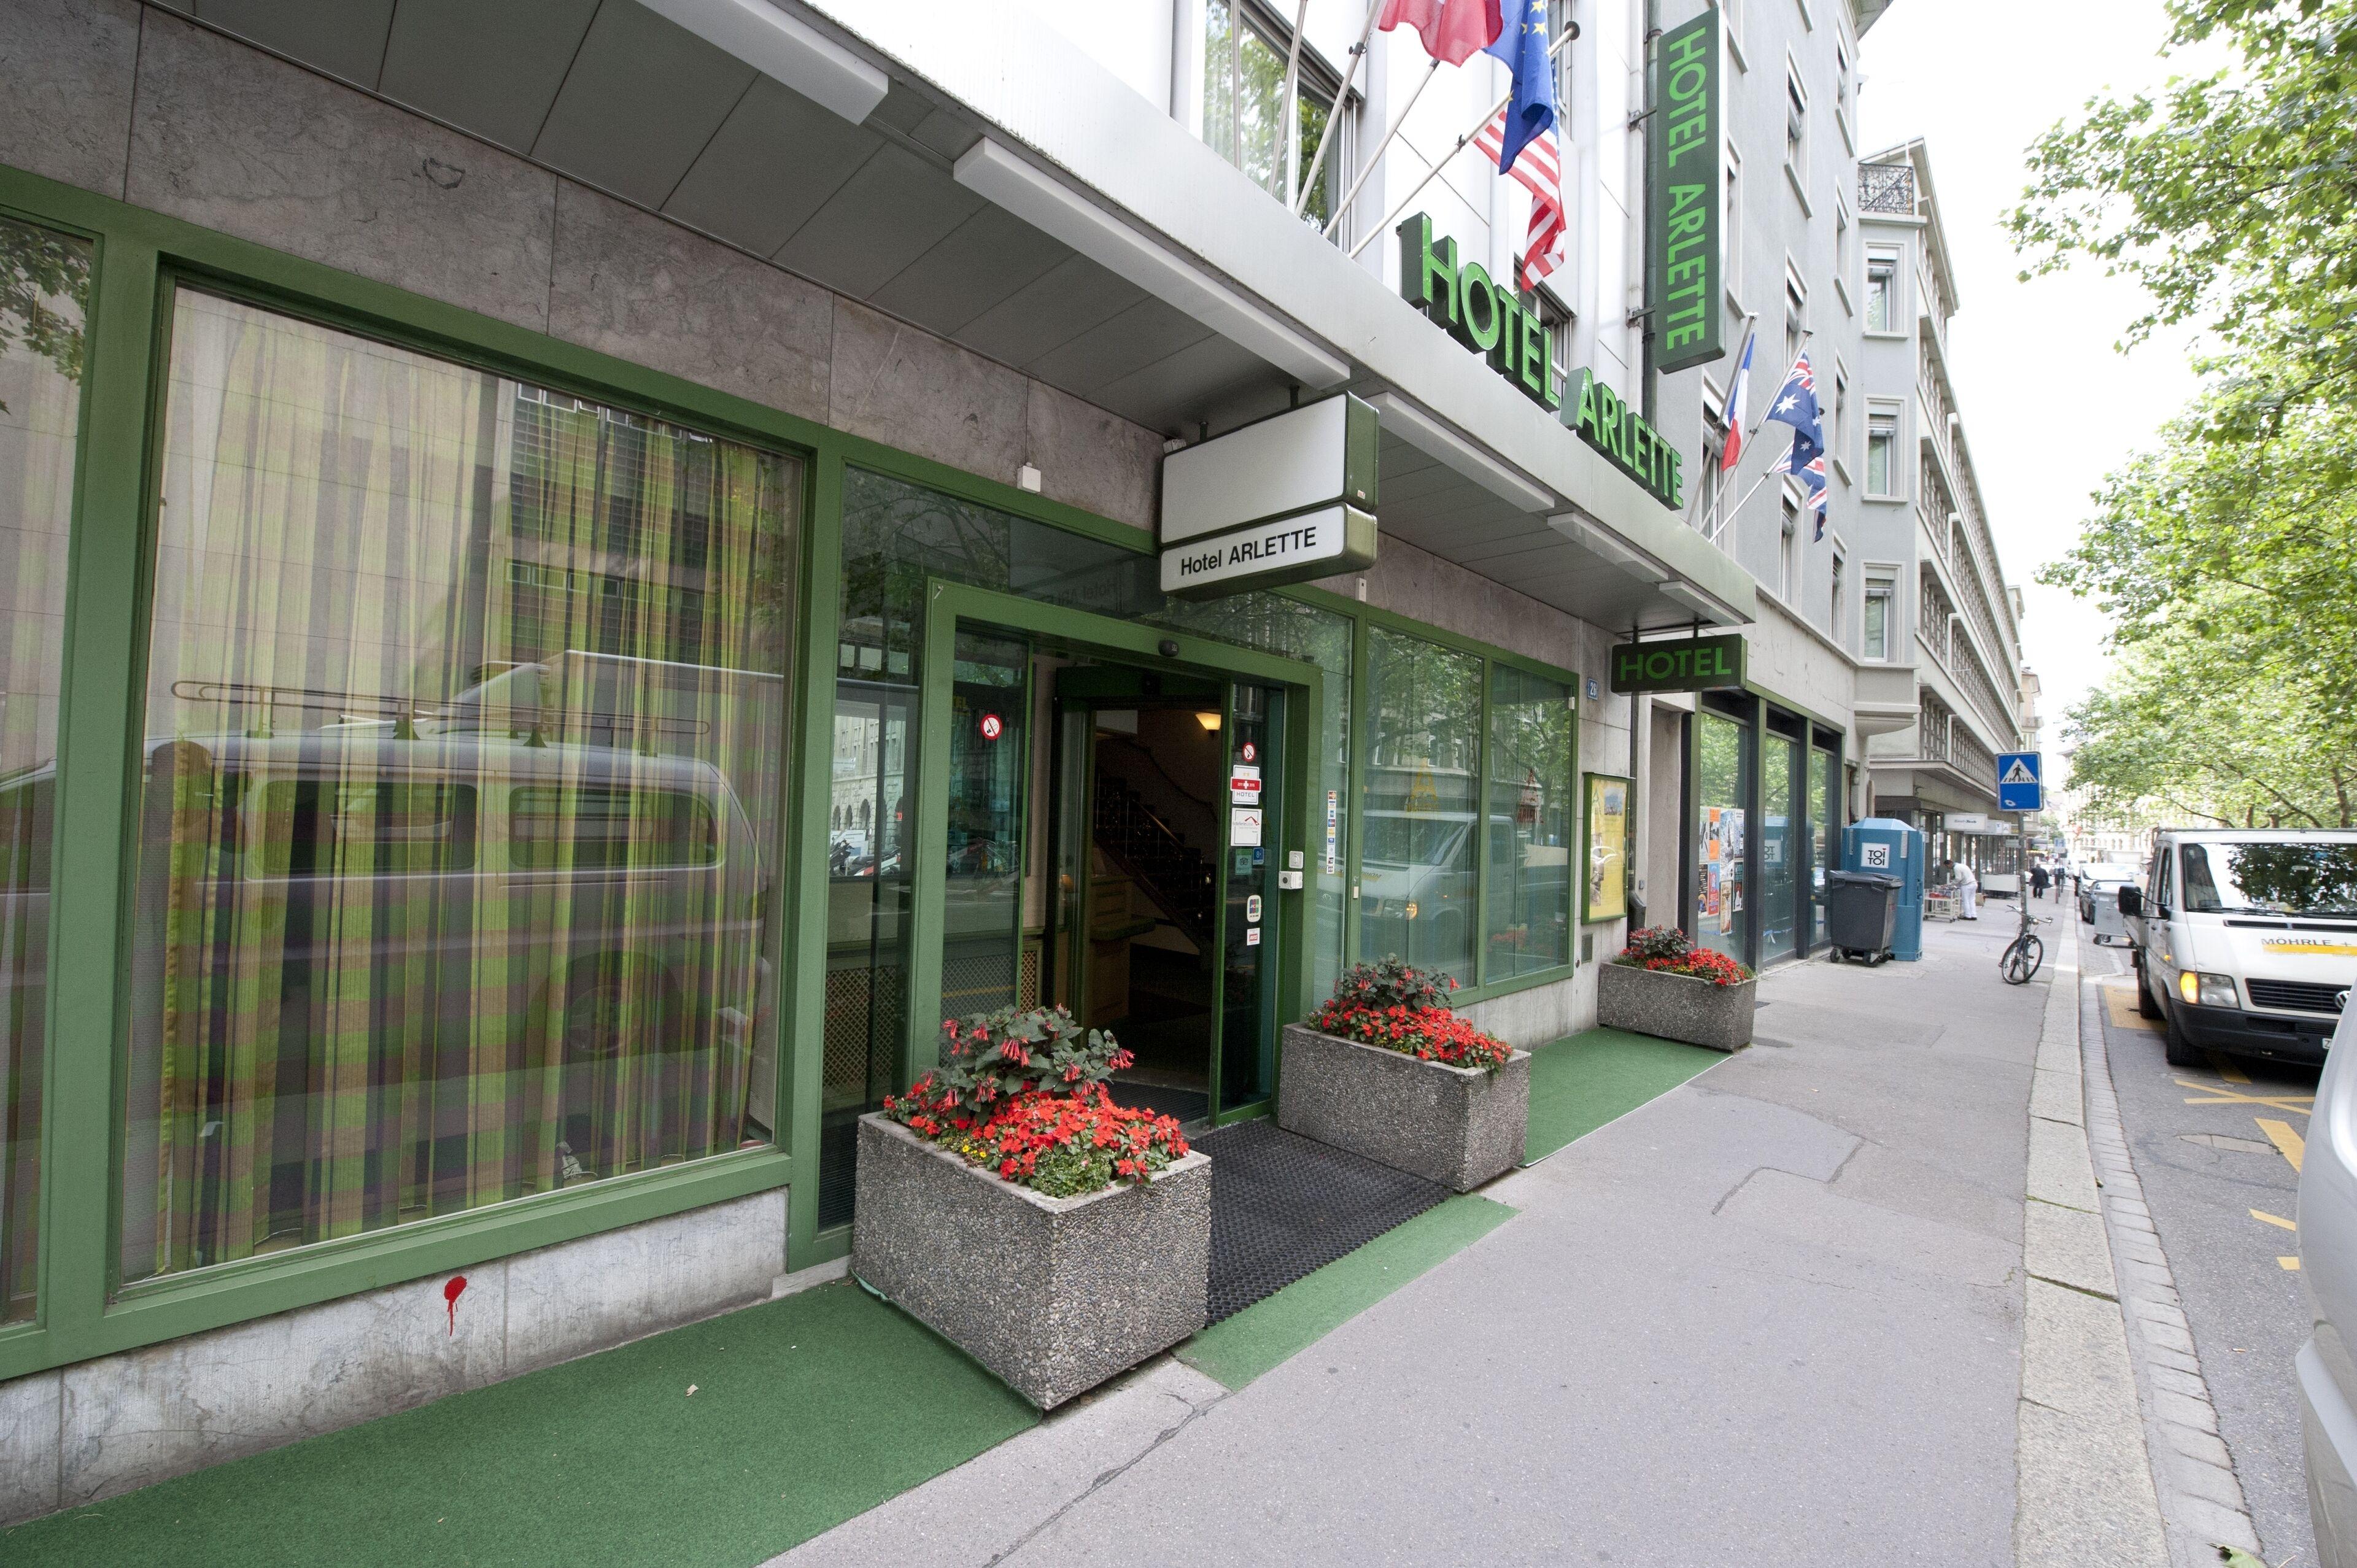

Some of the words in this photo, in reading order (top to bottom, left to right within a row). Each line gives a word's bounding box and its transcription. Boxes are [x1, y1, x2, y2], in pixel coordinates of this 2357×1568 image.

[1668, 26, 1706, 168] HOTEL
[1666, 184, 1706, 350] ARLETTE
[1419, 211, 1560, 411] HOTEL
[1573, 366, 1684, 510] ARLETTE
[1181, 549, 1222, 576] Hotel
[1228, 526, 1317, 565] ARLETTE
[1620, 647, 1732, 681] HOTEL
[2261, 937, 2334, 946] MÖHRLE
